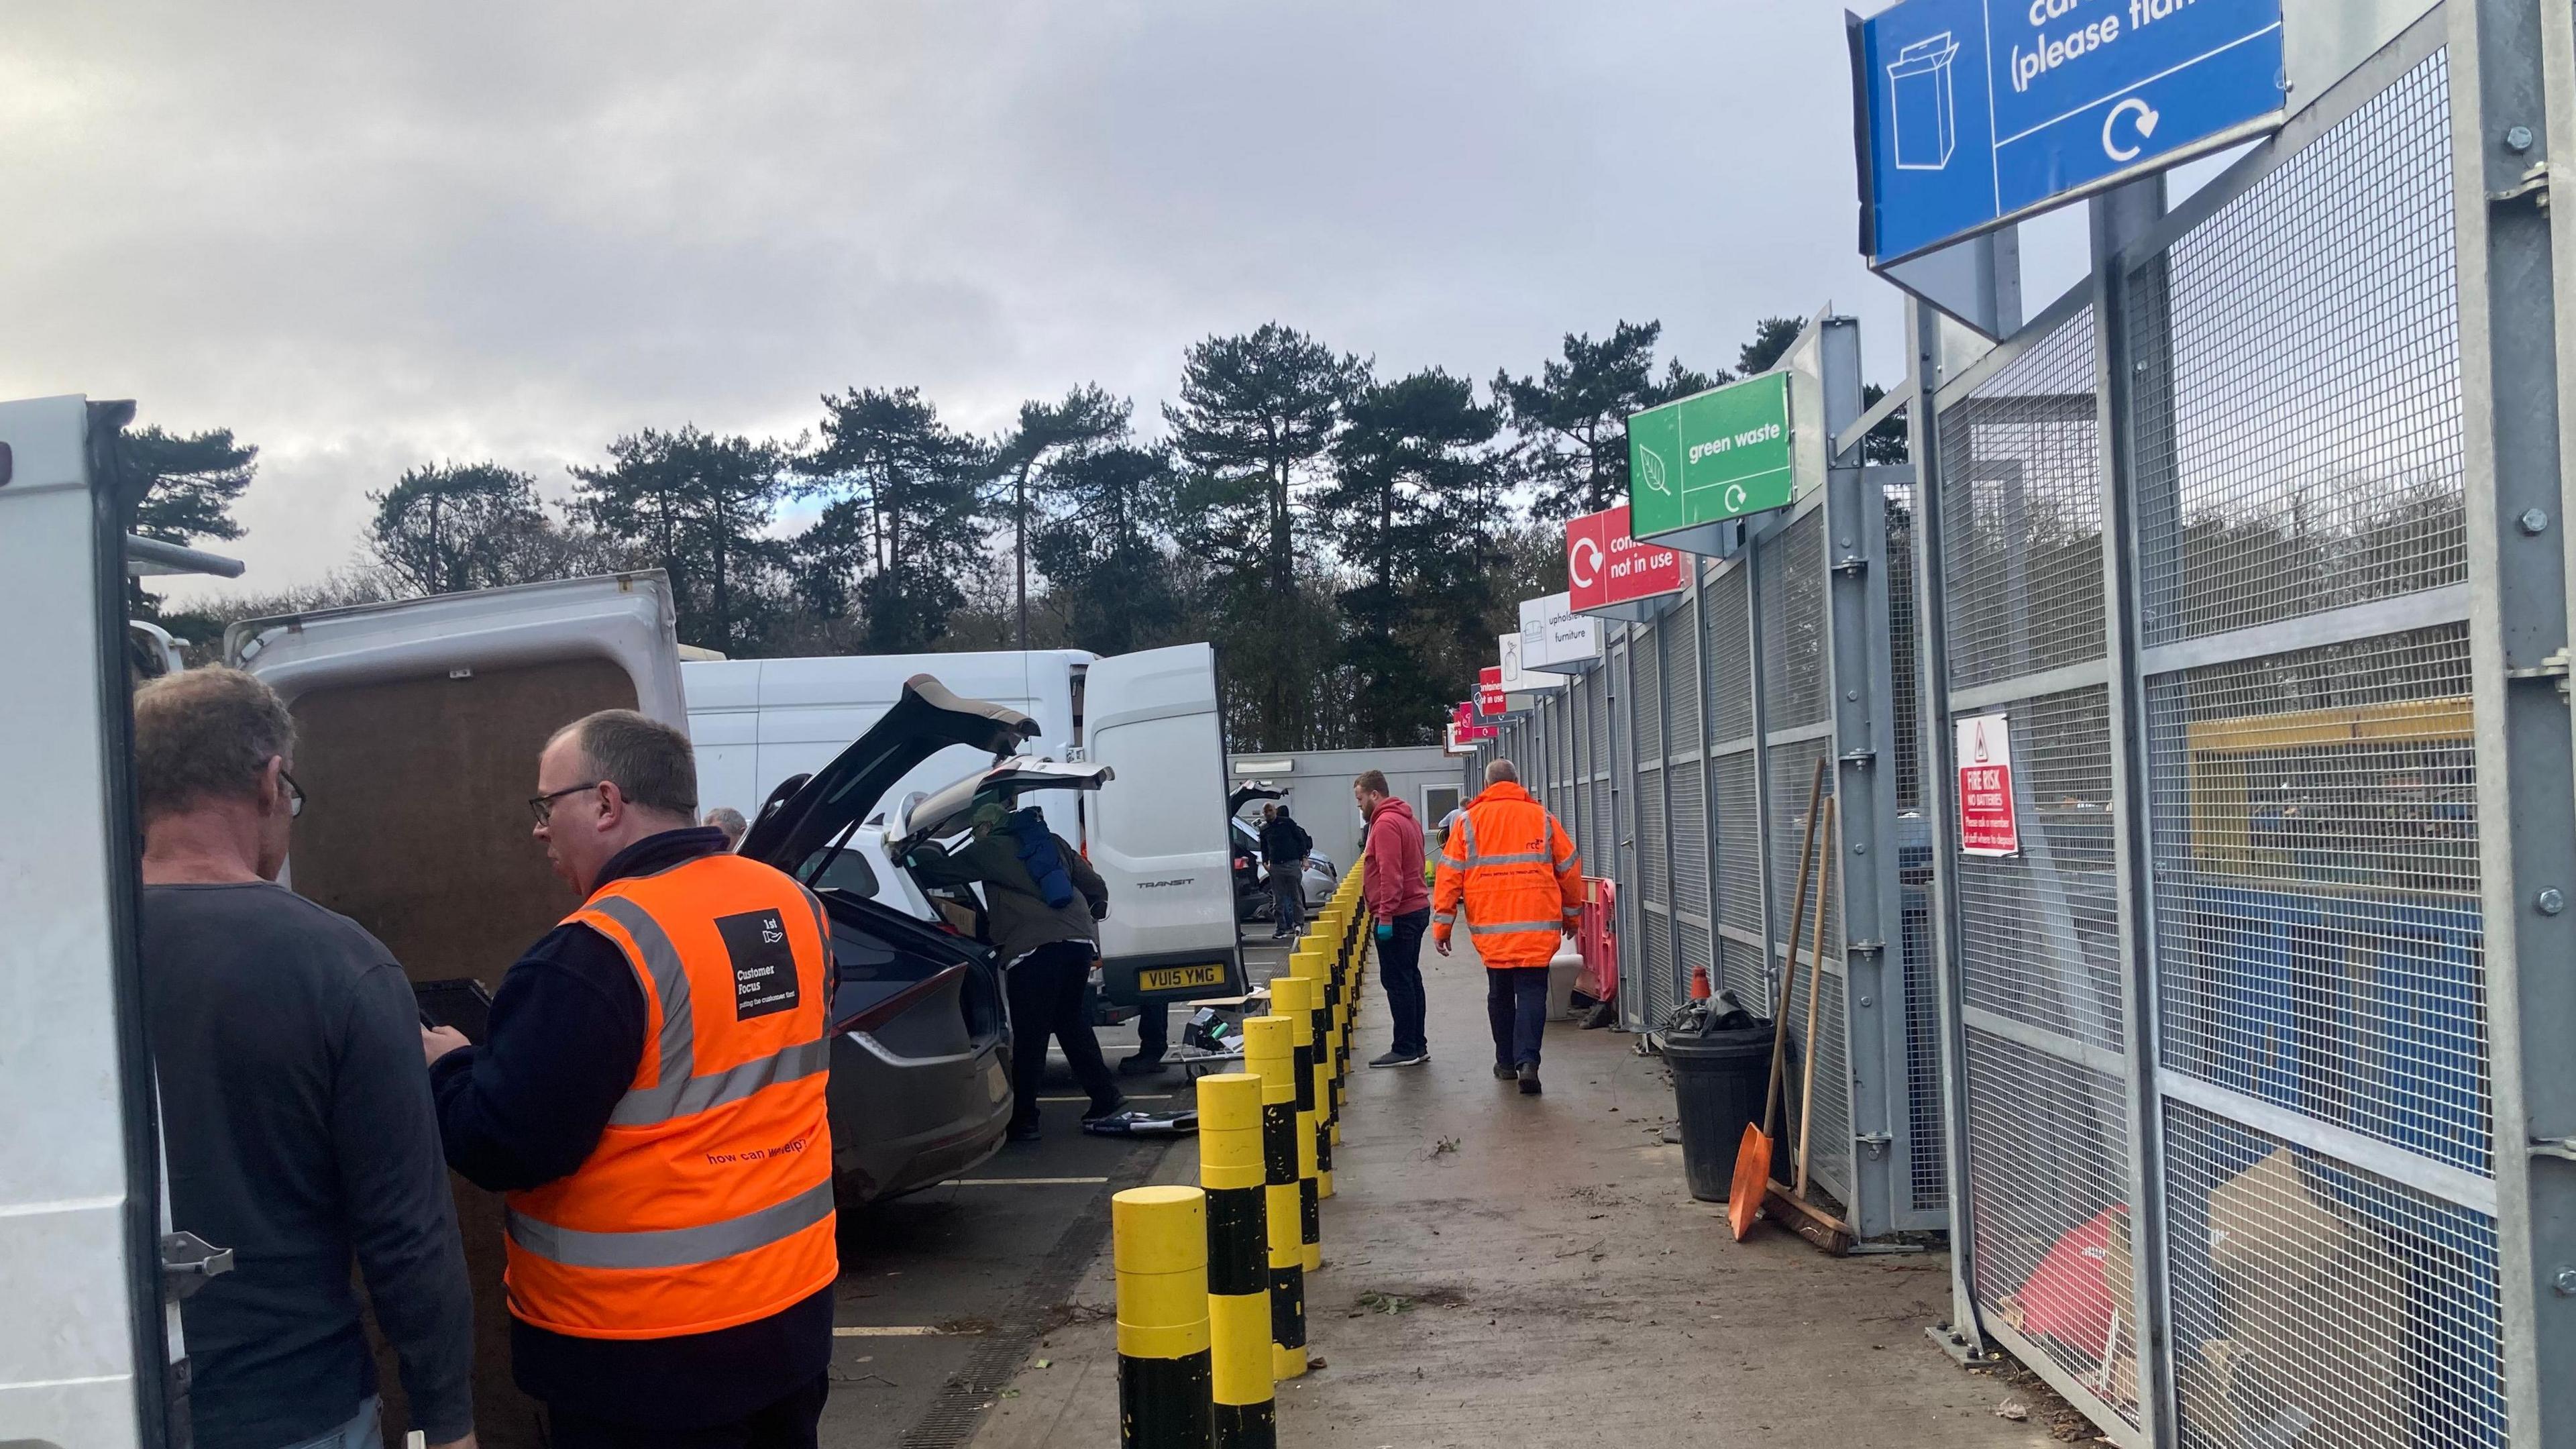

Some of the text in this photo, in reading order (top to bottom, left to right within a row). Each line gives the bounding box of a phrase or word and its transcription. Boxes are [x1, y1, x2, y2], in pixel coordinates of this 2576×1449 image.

[2012, 15, 2120, 93] (please
[1688, 423, 1780, 464] green waste
[1611, 535, 1645, 553] con
[1611, 551, 1673, 579] not in use
[1555, 630, 1585, 642] furniture
[1487, 693, 1493, 704] in
[1493, 695, 1504, 704] use
[1968, 769, 2001, 791] FIRE RISK
[1968, 793, 2002, 806] NO BATTERIES
[1137, 878, 1195, 889] TRANSIT
[763, 918, 777, 929] 1st
[737, 965, 775, 981] Customer
[1149, 968, 1214, 987] VU15 YMG
[738, 981, 761, 995] Focus
[761, 993, 785, 1003] customer
[706, 1153, 737, 1165] how
[741, 1149, 765, 1161] can
